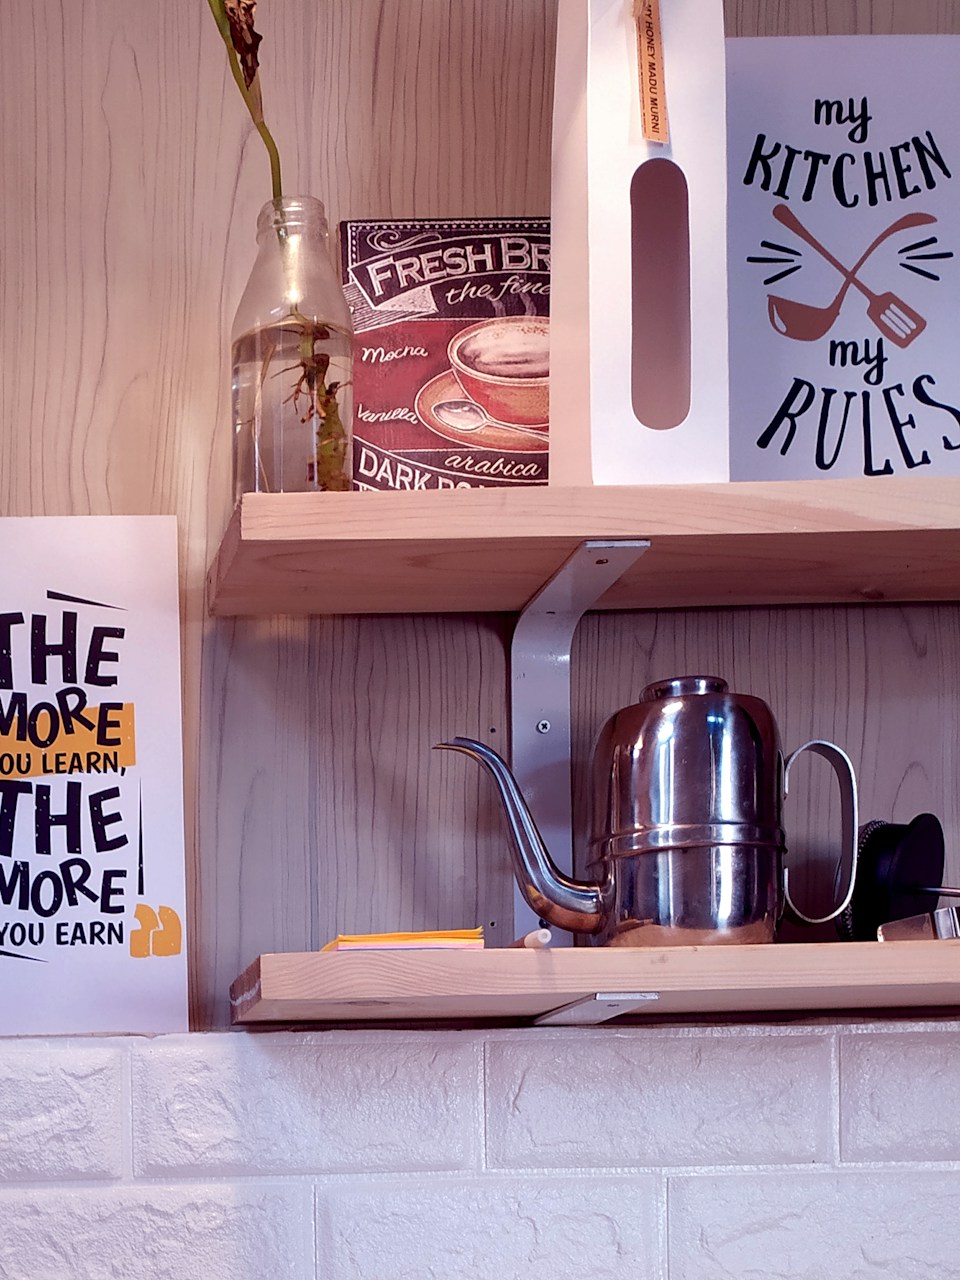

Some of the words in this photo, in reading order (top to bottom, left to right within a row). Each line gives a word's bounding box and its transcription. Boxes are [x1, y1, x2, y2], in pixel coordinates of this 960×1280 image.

[645, 21, 656, 60] HONEY
[648, 61, 658, 95] MADU
[650, 97, 660, 133] MURNI
[814, 97, 872, 144] my
[743, 130, 952, 208] KITCHEN
[366, 244, 494, 297] FRESH
[445, 281, 493, 305] the
[829, 337, 888, 385] my
[357, 403, 418, 424] Vanilla
[756, 374, 960, 476] RULES
[359, 447, 431, 490] DARK
[444, 454, 542, 477] arabica
[41, 751, 127, 780] LEARN,
[55, 921, 124, 946] EARN
